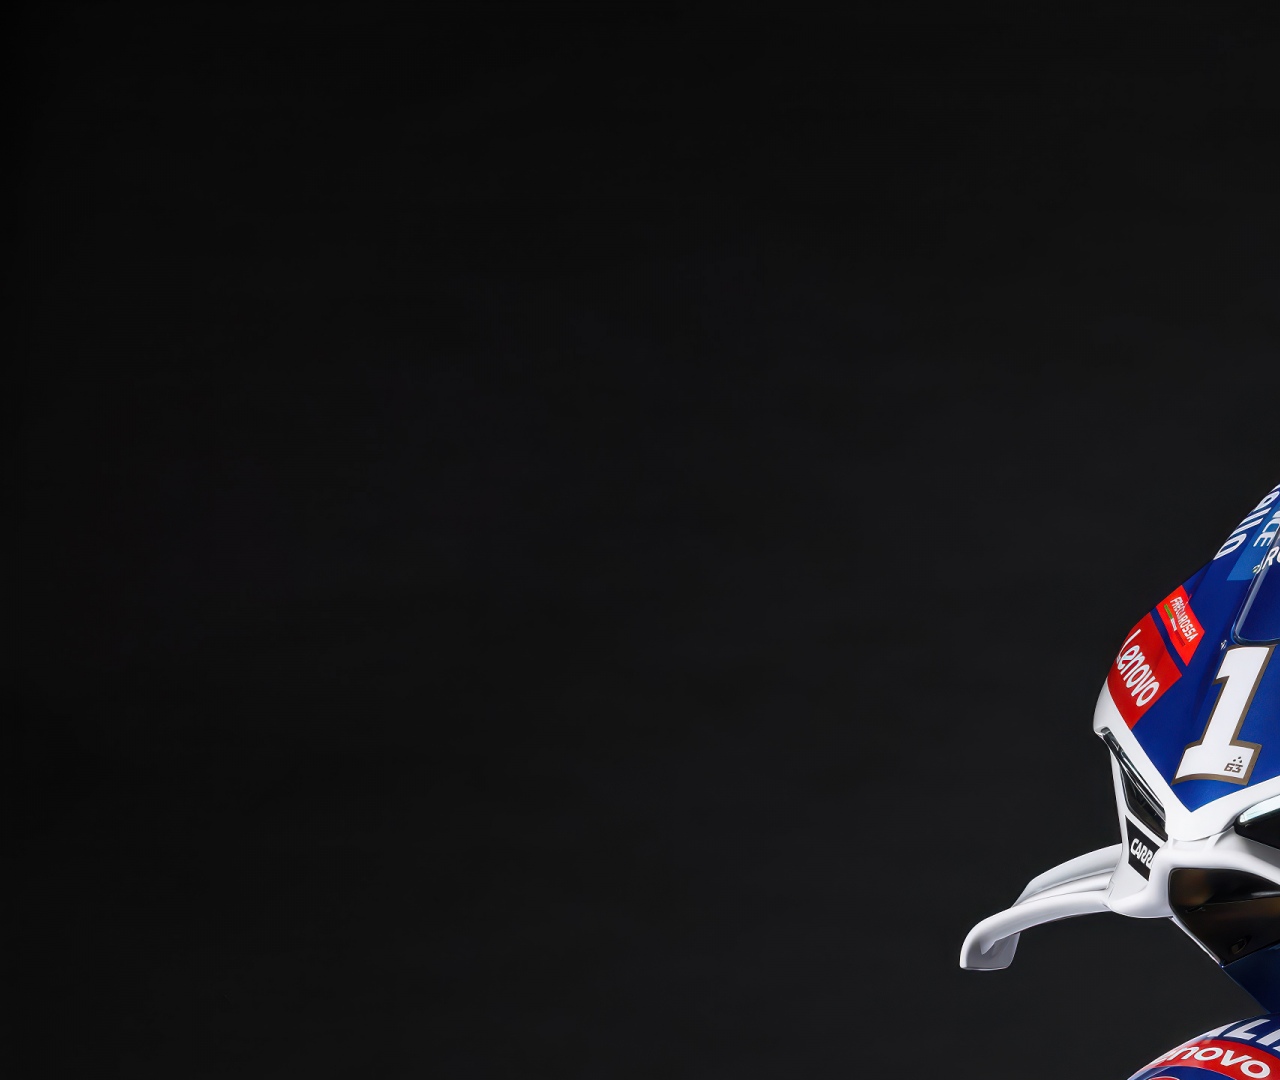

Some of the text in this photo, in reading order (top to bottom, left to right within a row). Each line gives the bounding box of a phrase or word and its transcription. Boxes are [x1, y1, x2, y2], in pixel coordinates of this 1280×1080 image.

[1116, 628, 1160, 708] Lenovo
[1173, 645, 1275, 783] 1
[1224, 762, 1244, 774] 63
[1130, 838, 1154, 870] CARR
[1155, 1046, 1271, 1079] novo
